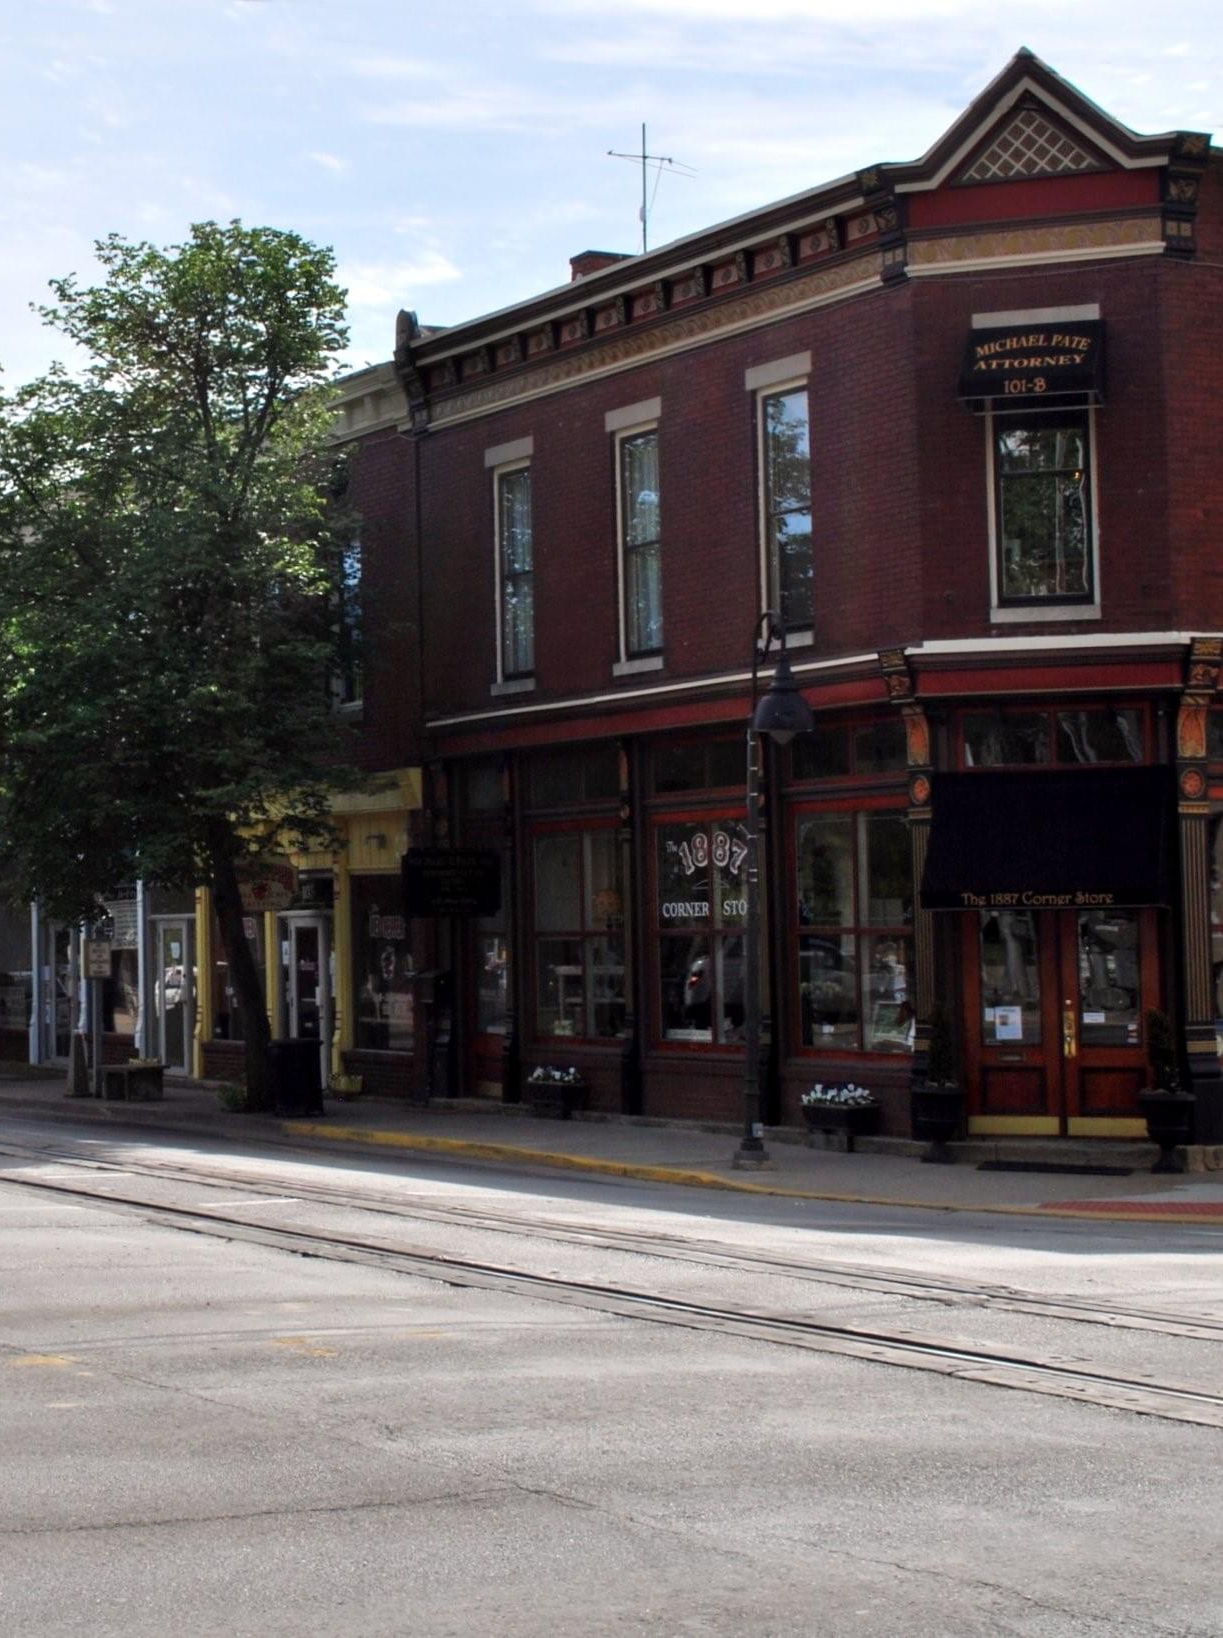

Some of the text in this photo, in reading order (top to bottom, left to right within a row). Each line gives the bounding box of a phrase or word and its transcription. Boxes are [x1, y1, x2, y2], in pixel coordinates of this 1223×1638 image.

[976, 335, 1090, 358] MICHAEL PATE
[974, 354, 1084, 370] ATTORNEY
[1003, 377, 1046, 393] 101-B
[678, 831, 748, 875] 1887
[960, 890, 1114, 906] The 1887 Corner Store
[663, 900, 747, 917] CORNER STO
